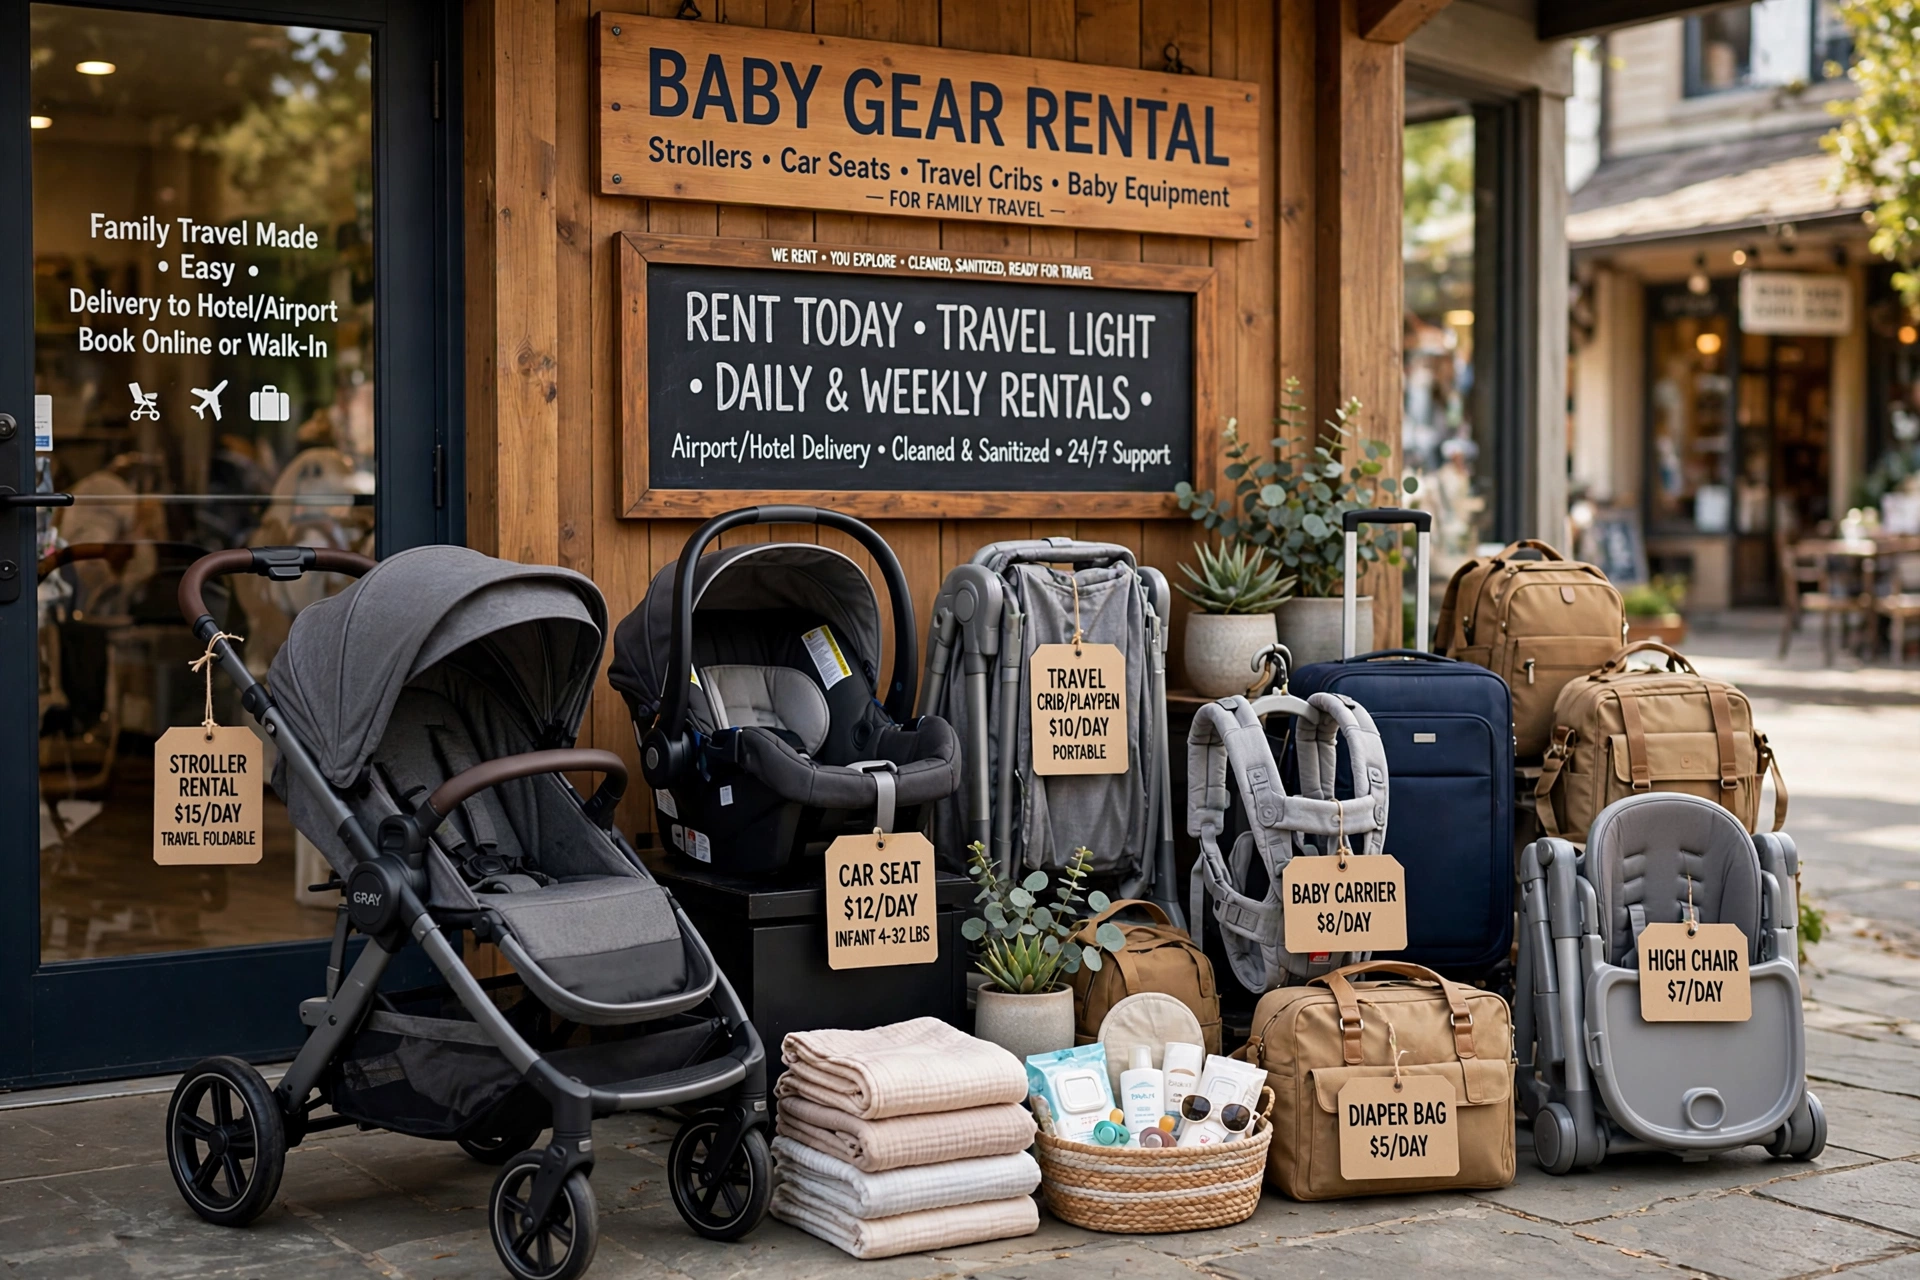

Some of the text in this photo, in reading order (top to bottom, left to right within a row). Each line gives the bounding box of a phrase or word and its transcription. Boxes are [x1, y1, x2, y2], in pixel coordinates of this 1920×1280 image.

[648, 47, 1229, 167] BABY GEAR RENTAL
[648, 136, 1229, 209] Strollers Car Seats Travel Cribs Baby Equipment
[890, 190, 1044, 218] FOR FAMILY TRAVEL
[91, 213, 318, 249] Family Travel Made
[181, 254, 235, 286] Easy
[772, 247, 1093, 280] WE RENT YOU EXPLORE CLEANED, SANITIZED, READY FOR TRAVEL
[70, 288, 338, 327] Delivery to Hotel/Airport
[686, 291, 1155, 359] RENT TODAY TRAVEL LIGHT
[79, 327, 327, 357] Book Online or Walk-In
[716, 362, 1130, 421] DAILY & WEEKLY RENTALS
[672, 431, 1171, 472] Airport/Hotel Delivery Cleaned & Sanitized 24/7 Support
[1047, 668, 1106, 689] TRAVEL
[1037, 691, 1119, 712] CRIB/PLAYPEN
[1050, 716, 1109, 739] $10/DAY
[170, 754, 247, 774] STROLLER
[1053, 744, 1106, 760] PORTABLE
[180, 777, 238, 796] RENTAL
[175, 802, 242, 826] $15/DAY
[162, 831, 255, 845] TRAVEL FOLDABLE
[839, 861, 920, 887] CAR SEAT
[354, 892, 382, 906] GRAY
[1292, 882, 1396, 904] BABY CARRIER
[844, 893, 918, 922] $12/DAY
[1318, 910, 1371, 935] $8/DAY
[836, 925, 930, 947] INFANT 4-32 LBS
[1648, 949, 1738, 971] HIGH CHAIR
[1668, 978, 1723, 1005] $7/DAY
[1349, 1102, 1446, 1126] DIAPER BAG
[1370, 1133, 1428, 1160] $5/DAY
